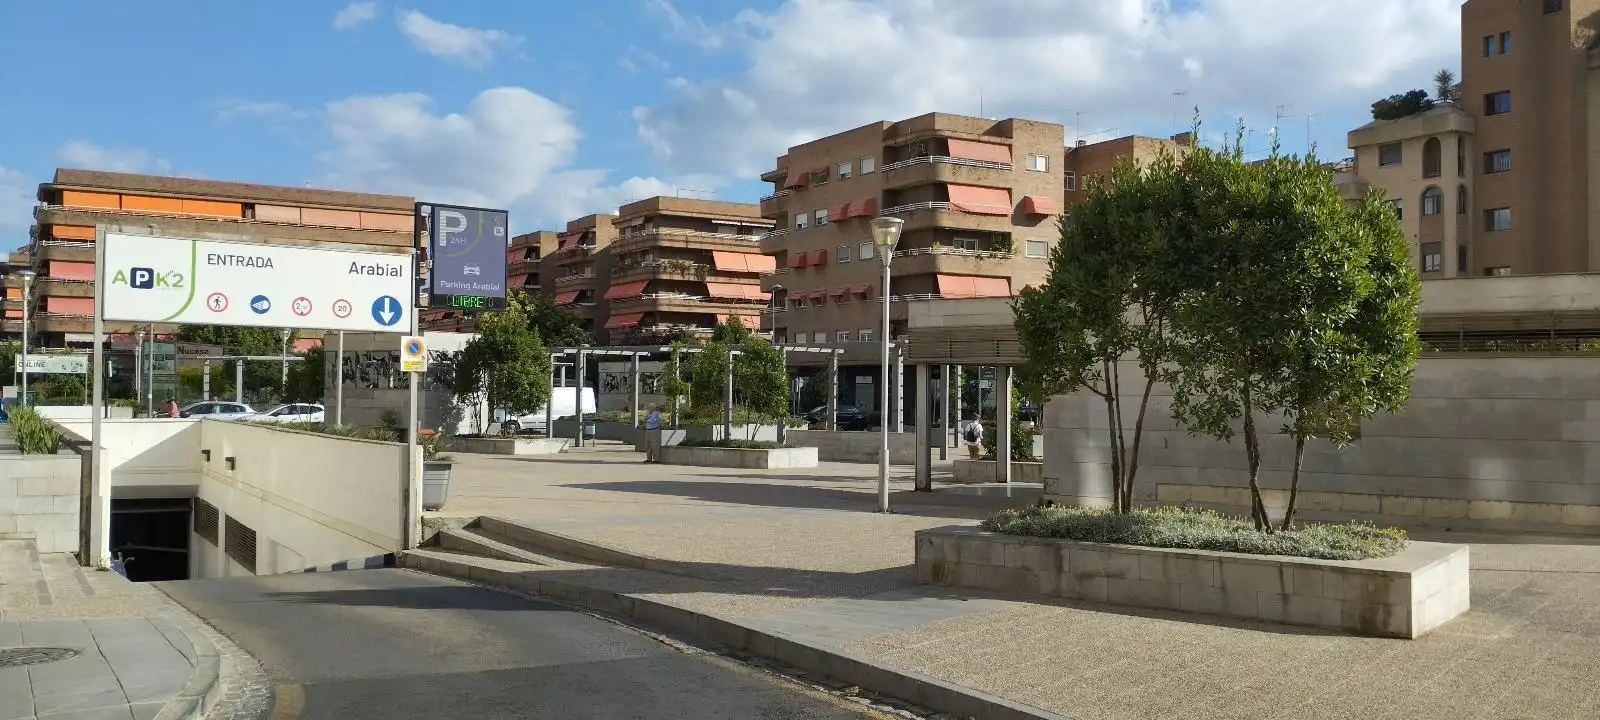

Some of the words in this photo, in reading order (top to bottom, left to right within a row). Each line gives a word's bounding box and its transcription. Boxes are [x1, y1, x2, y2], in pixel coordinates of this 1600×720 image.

[207, 253, 274, 269] ENTRADA
[348, 261, 402, 278] Arabial
[440, 280, 471, 291] Parking
[472, 282, 500, 291] Arabial
[452, 295, 484, 308] LIBRE
